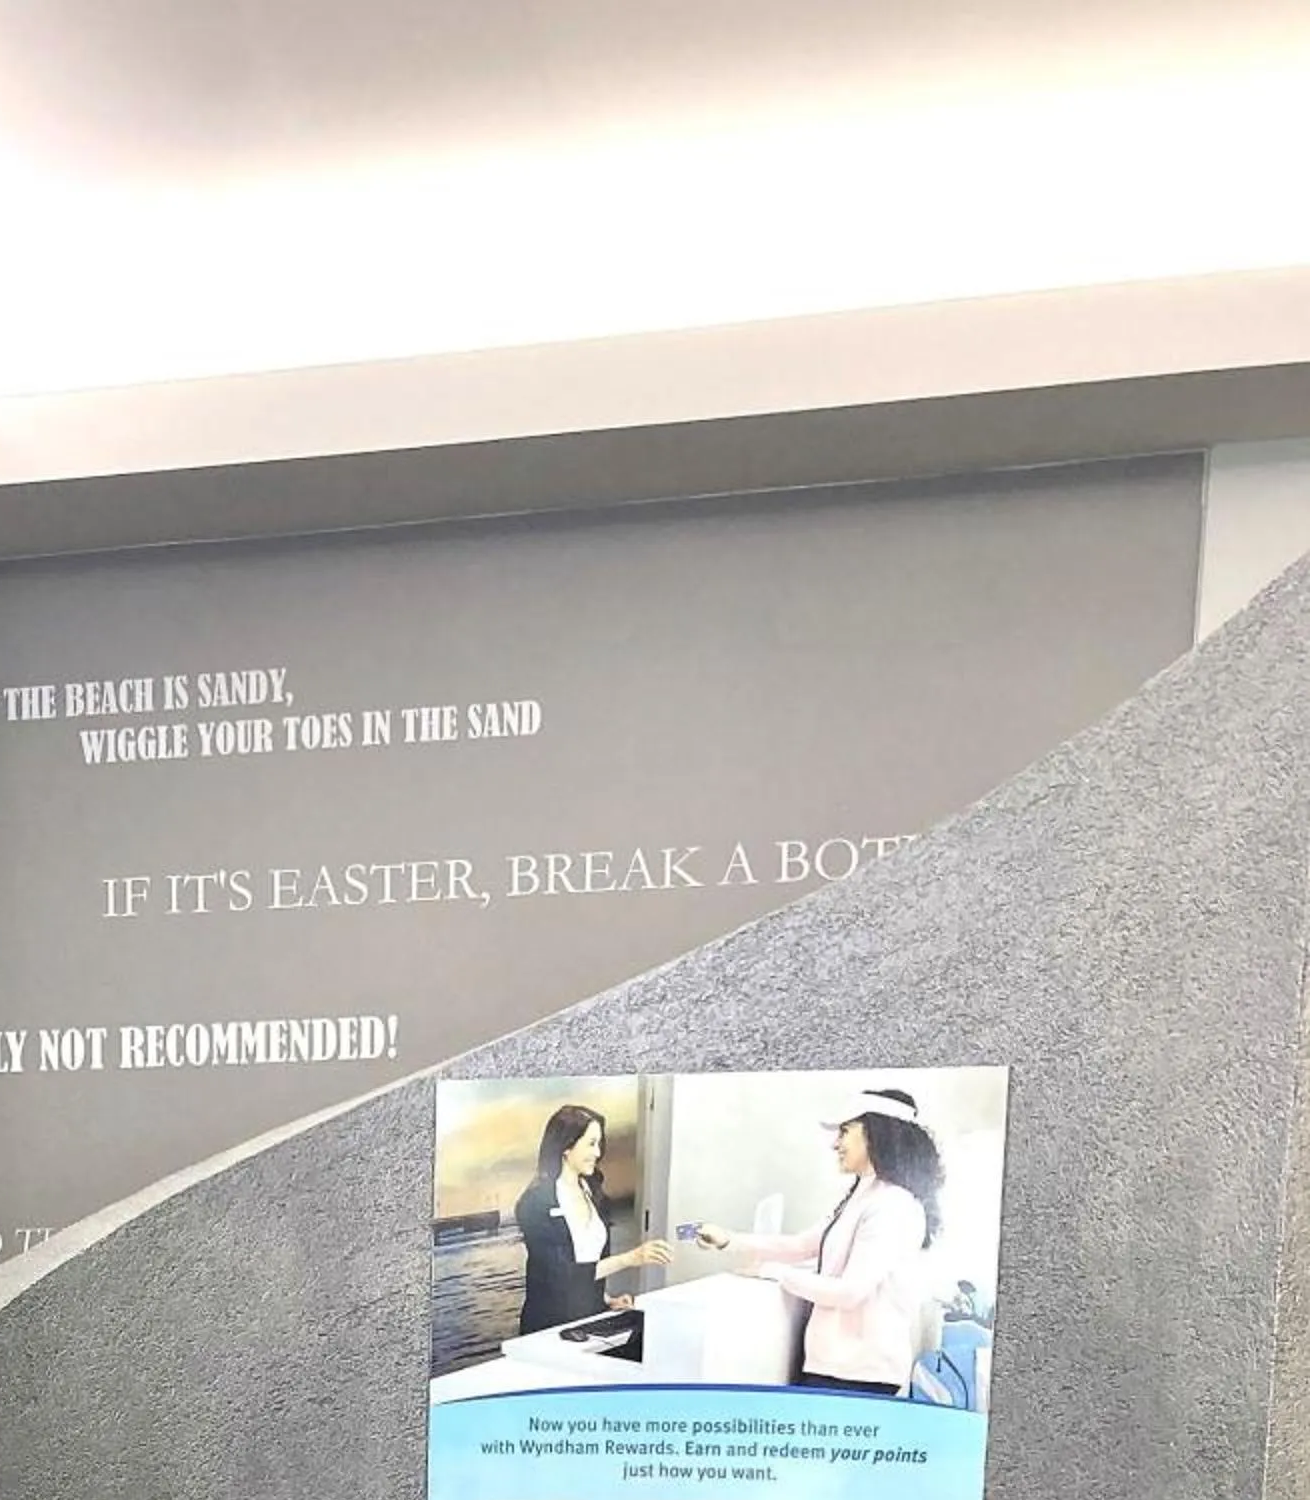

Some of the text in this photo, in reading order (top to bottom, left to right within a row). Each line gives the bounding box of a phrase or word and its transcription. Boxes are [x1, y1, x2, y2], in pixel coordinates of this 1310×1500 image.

[4, 685, 56, 722] THE
[65, 677, 154, 718] BEACH
[163, 675, 190, 710] IS
[197, 668, 294, 708] SANDY,
[80, 700, 541, 764] WIGGLE YOUR TOES IN THE SAND
[102, 834, 920, 918] IF IT'S EASTER, BREAK A BOT
[38, 1027, 106, 1072] NOT
[118, 1015, 399, 1069] RECOMMENDED!
[481, 1440, 927, 1463] with Wyndham Rewards. Earn and redeem your points
[529, 1417, 880, 1437] Now you have more possibilities than ever
[623, 1462, 777, 1481] just how you want.
